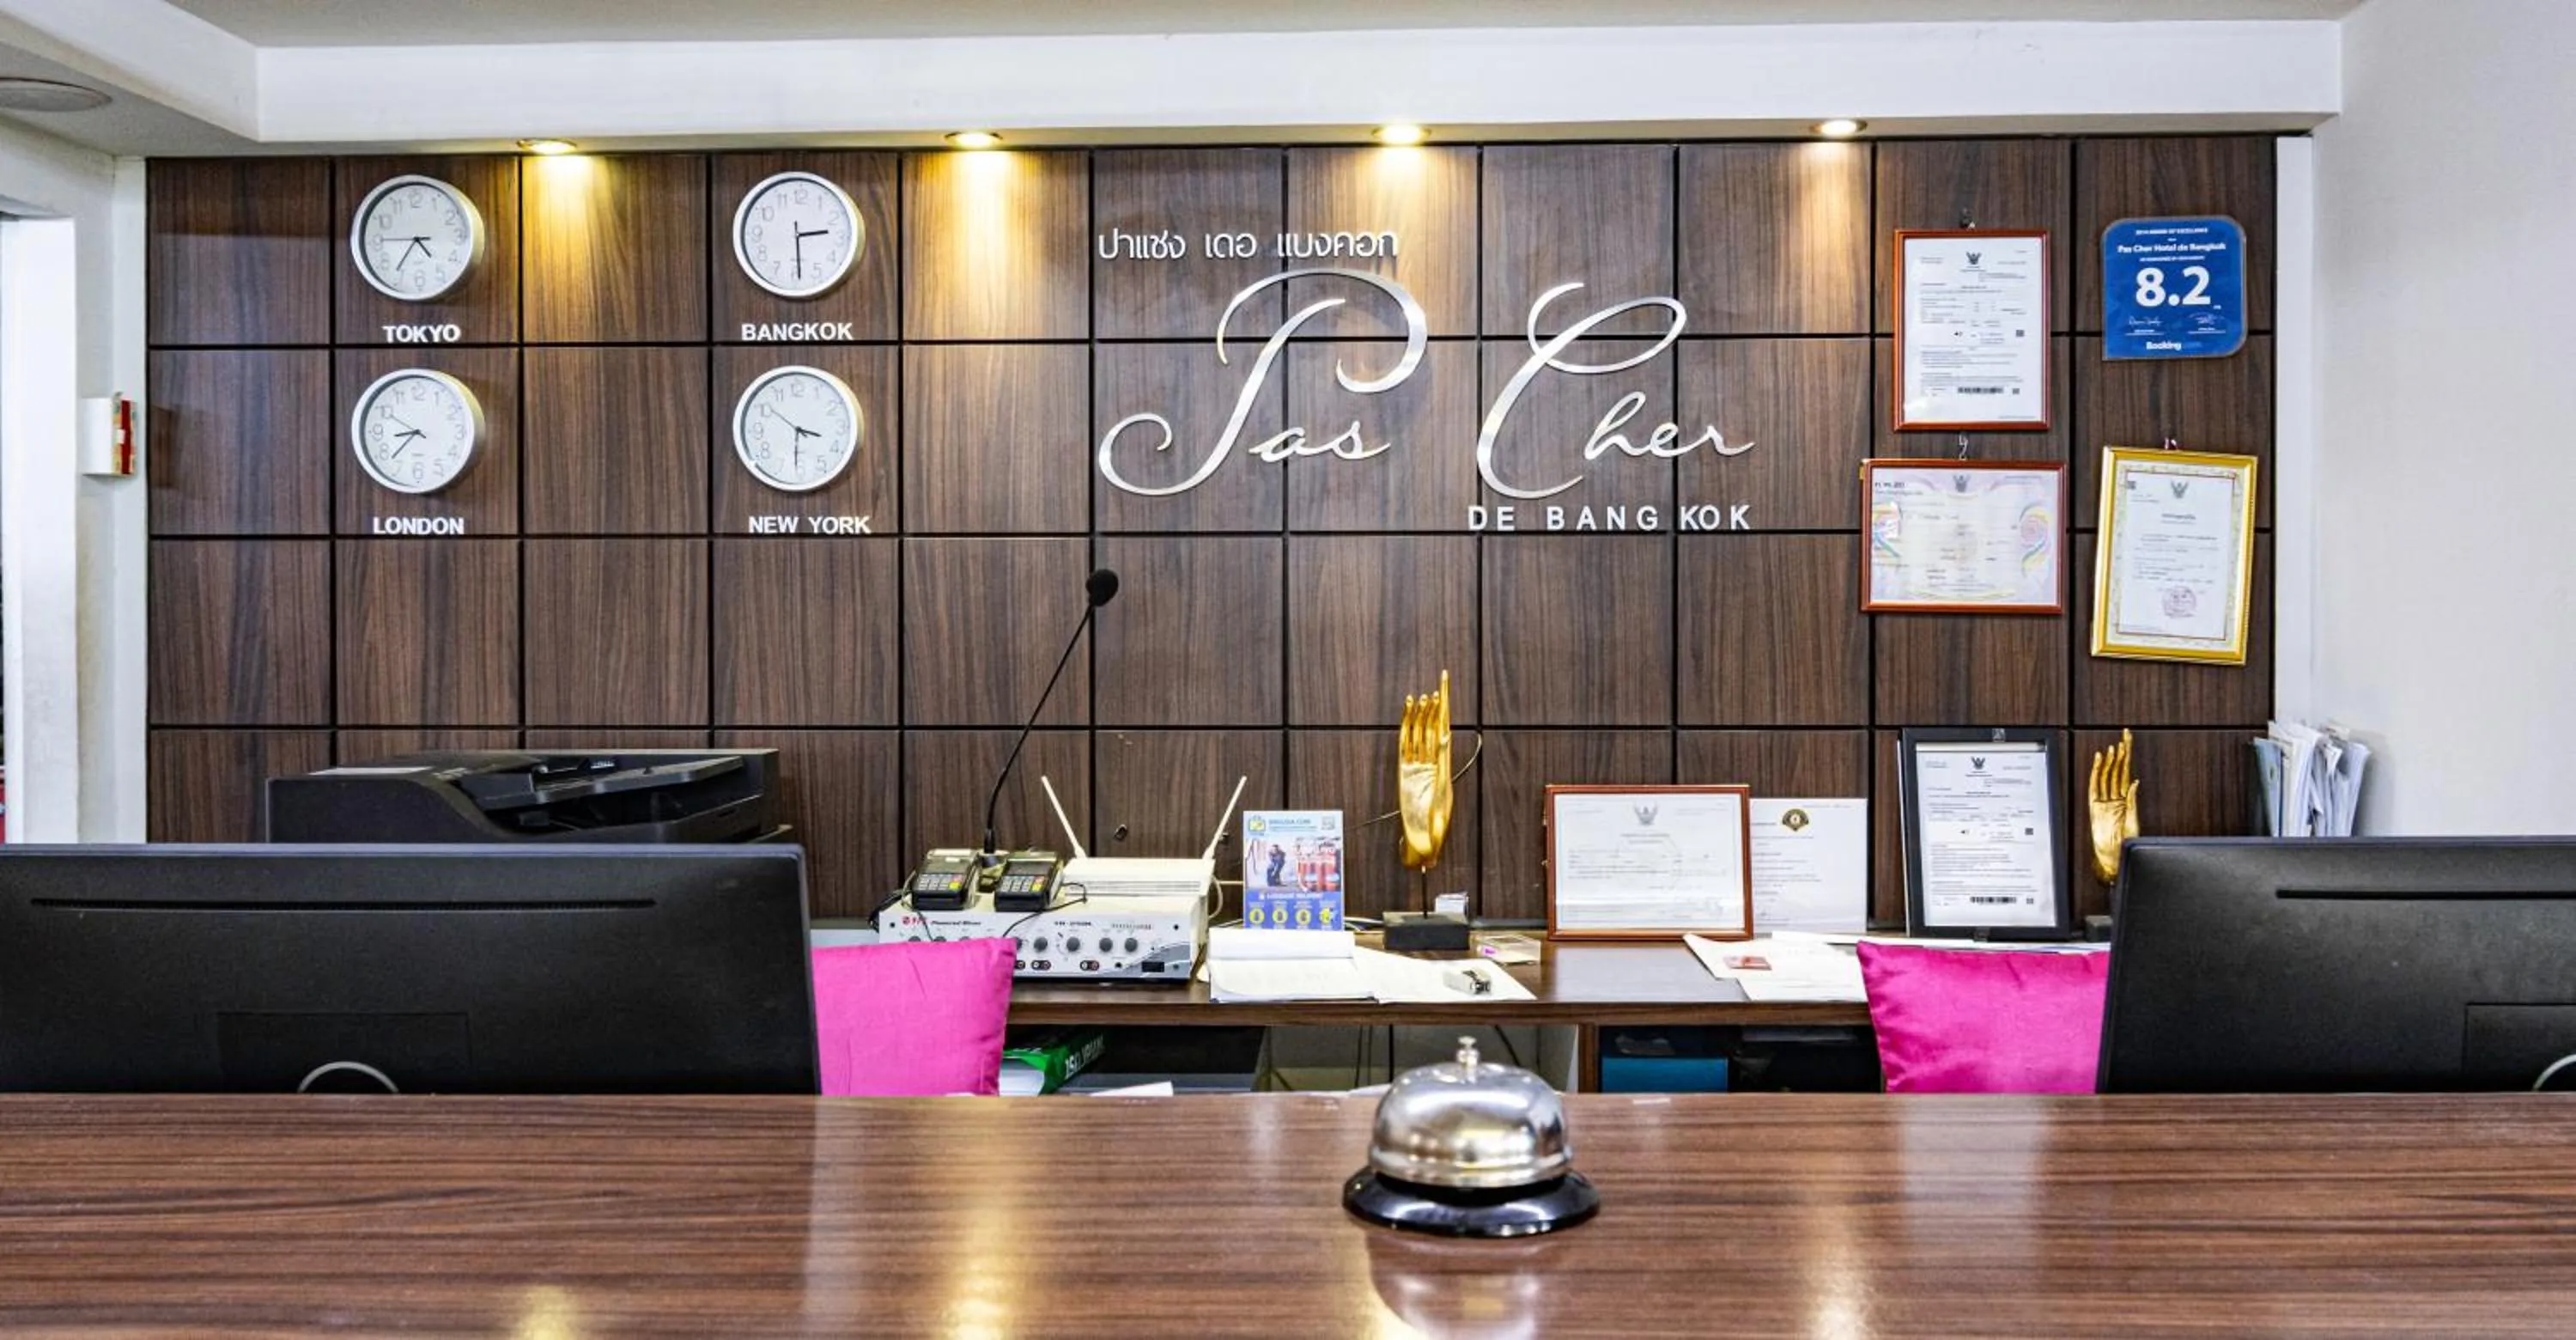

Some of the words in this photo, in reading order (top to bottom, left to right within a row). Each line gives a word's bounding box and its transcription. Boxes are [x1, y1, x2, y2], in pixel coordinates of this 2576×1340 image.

[1205, 233, 1257, 259] เดอ
[1278, 231, 1399, 258] แบงคอก
[2154, 243, 2177, 252] Hotel
[2178, 243, 2189, 252] de
[2136, 265, 2211, 307] 8.2
[382, 324, 462, 344] TOKYO
[741, 322, 854, 341] BANGKOK
[2146, 340, 2182, 350] Booking
[1099, 267, 1427, 496] Pas
[1477, 282, 1756, 499] Cher
[373, 516, 465, 534] LONDON
[749, 515, 799, 533] NEW
[808, 516, 872, 534] YORK
[1467, 506, 1516, 532] DE
